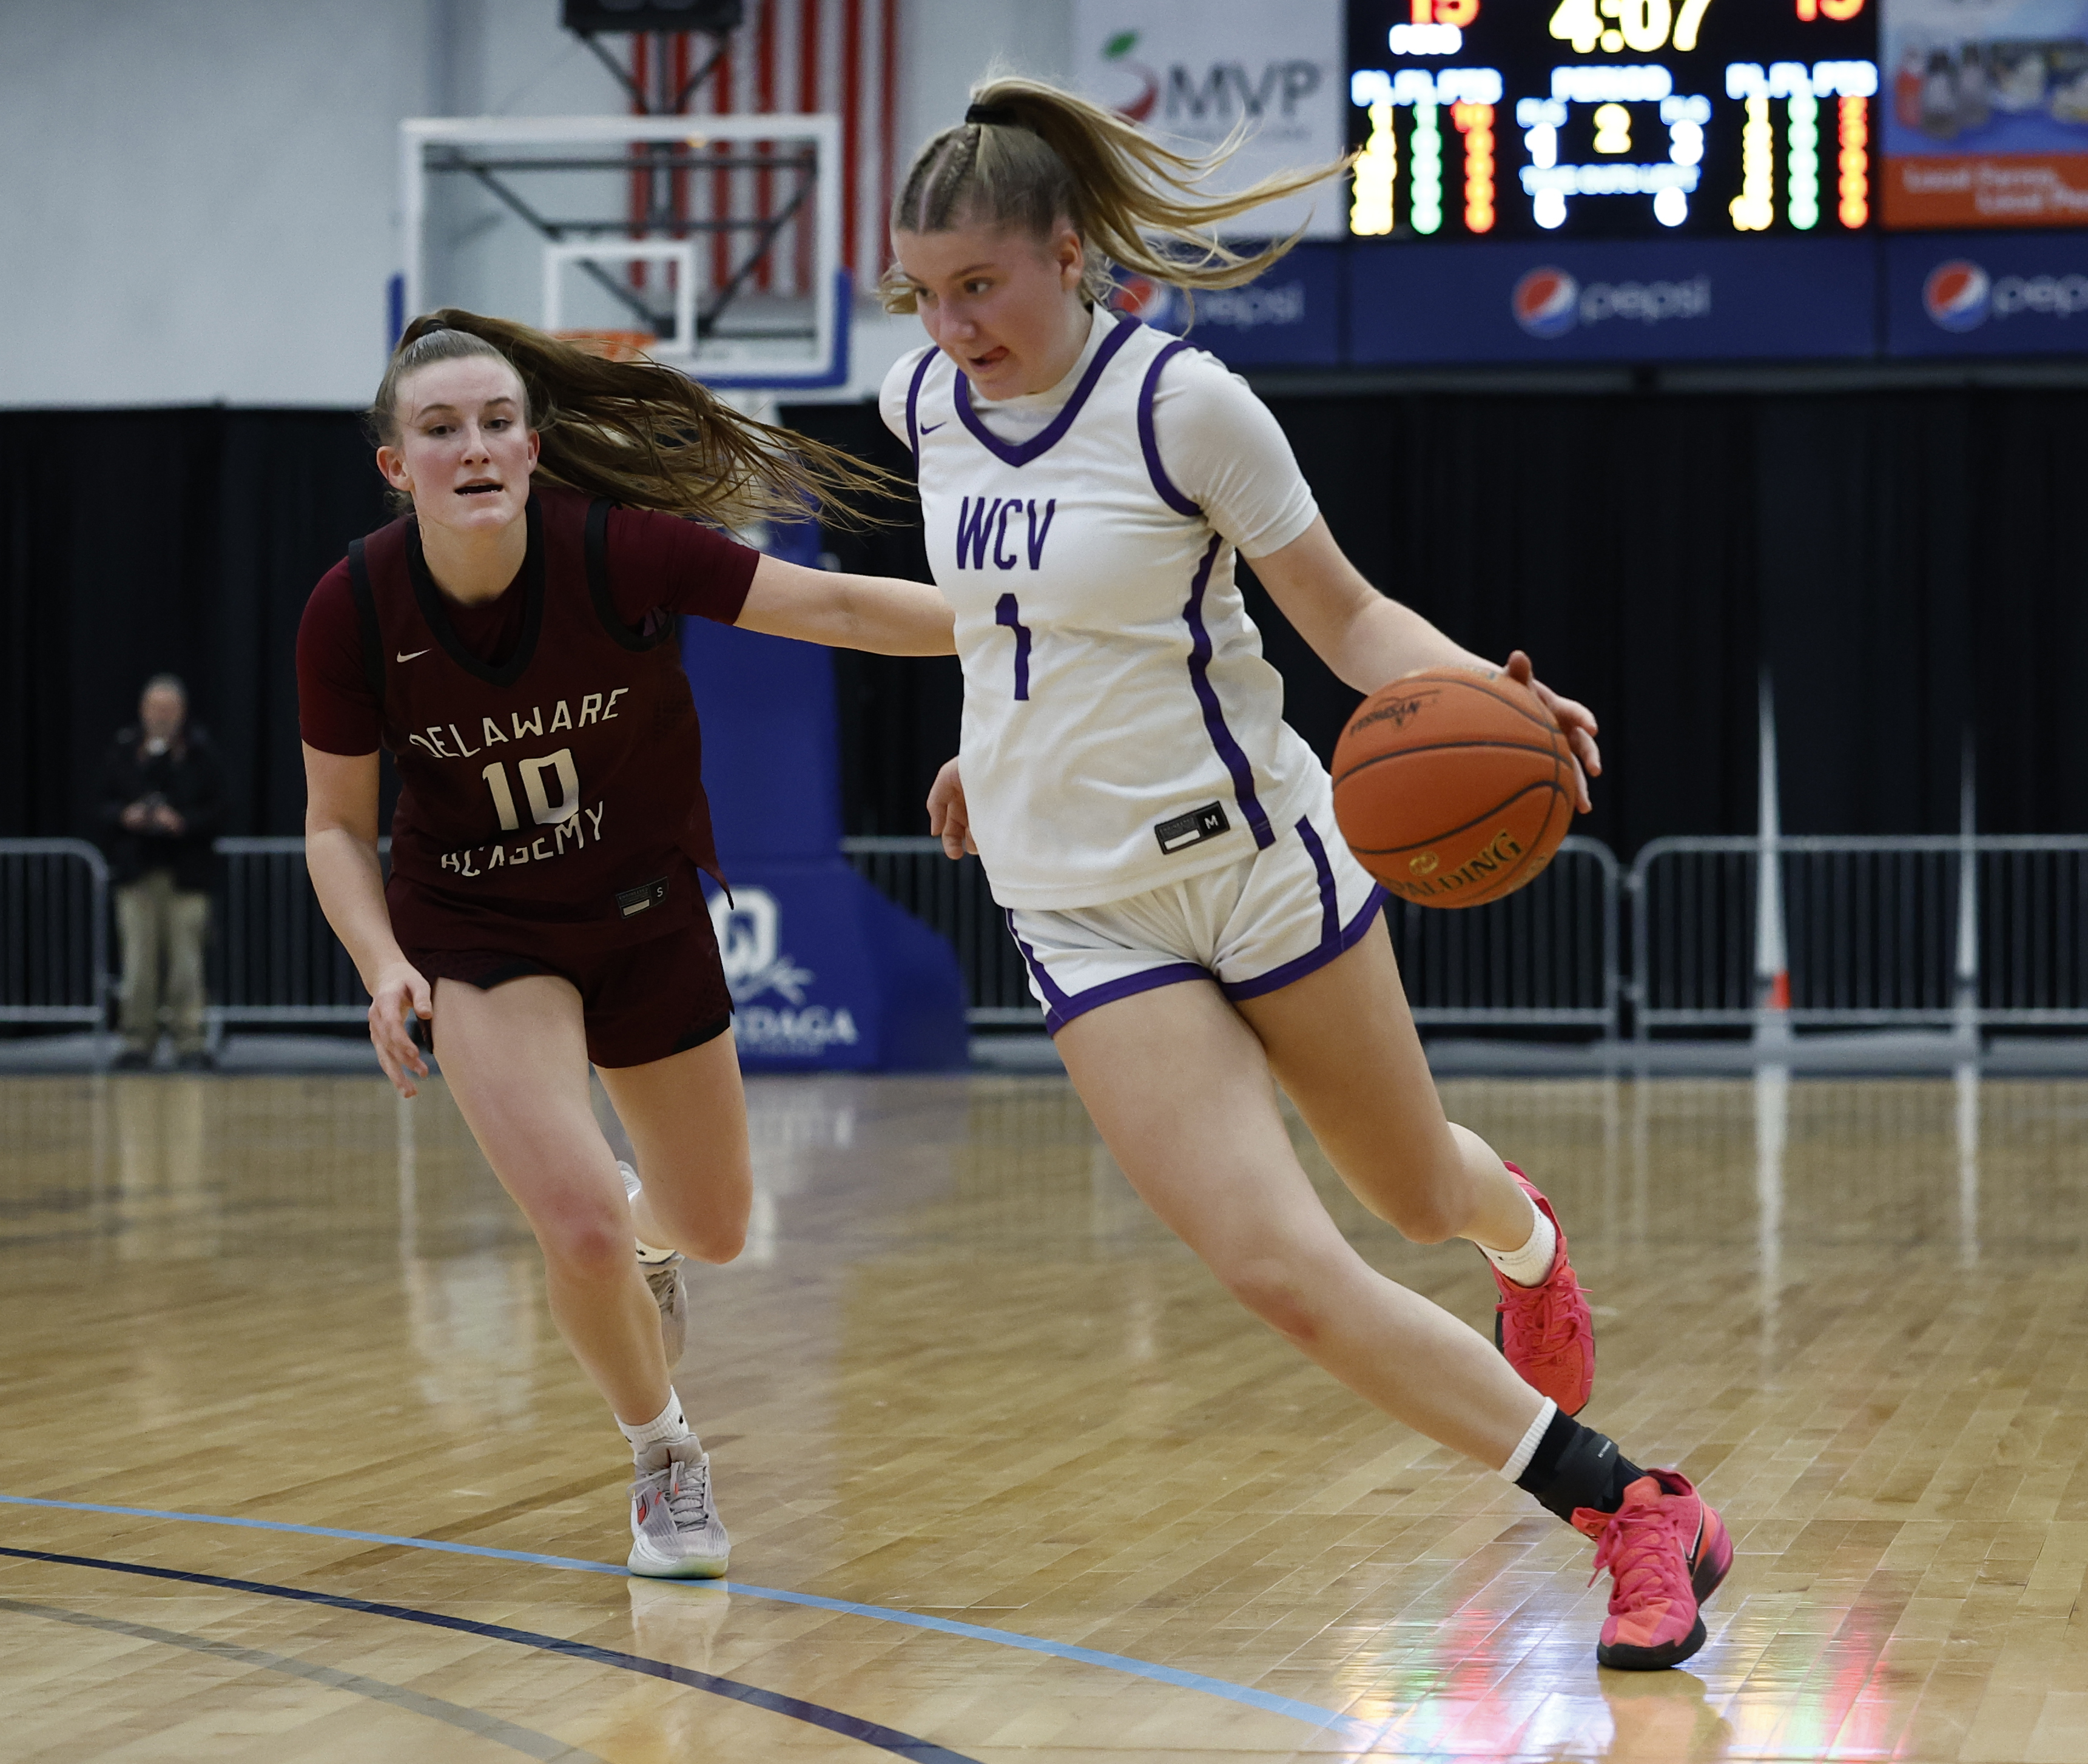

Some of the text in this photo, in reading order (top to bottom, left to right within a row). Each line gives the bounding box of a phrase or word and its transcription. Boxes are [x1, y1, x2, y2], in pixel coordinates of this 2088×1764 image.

[1549, 0, 1712, 53] 4:07
[1165, 61, 1322, 118] MVP
[1579, 273, 1711, 326] pepsi
[957, 496, 1056, 570] WCV
[995, 593, 1031, 701] 1
[482, 748, 579, 830] 10
[1204, 814, 1219, 830] M
[1372, 827, 1522, 898] PALDING
[656, 886, 664, 898] S
